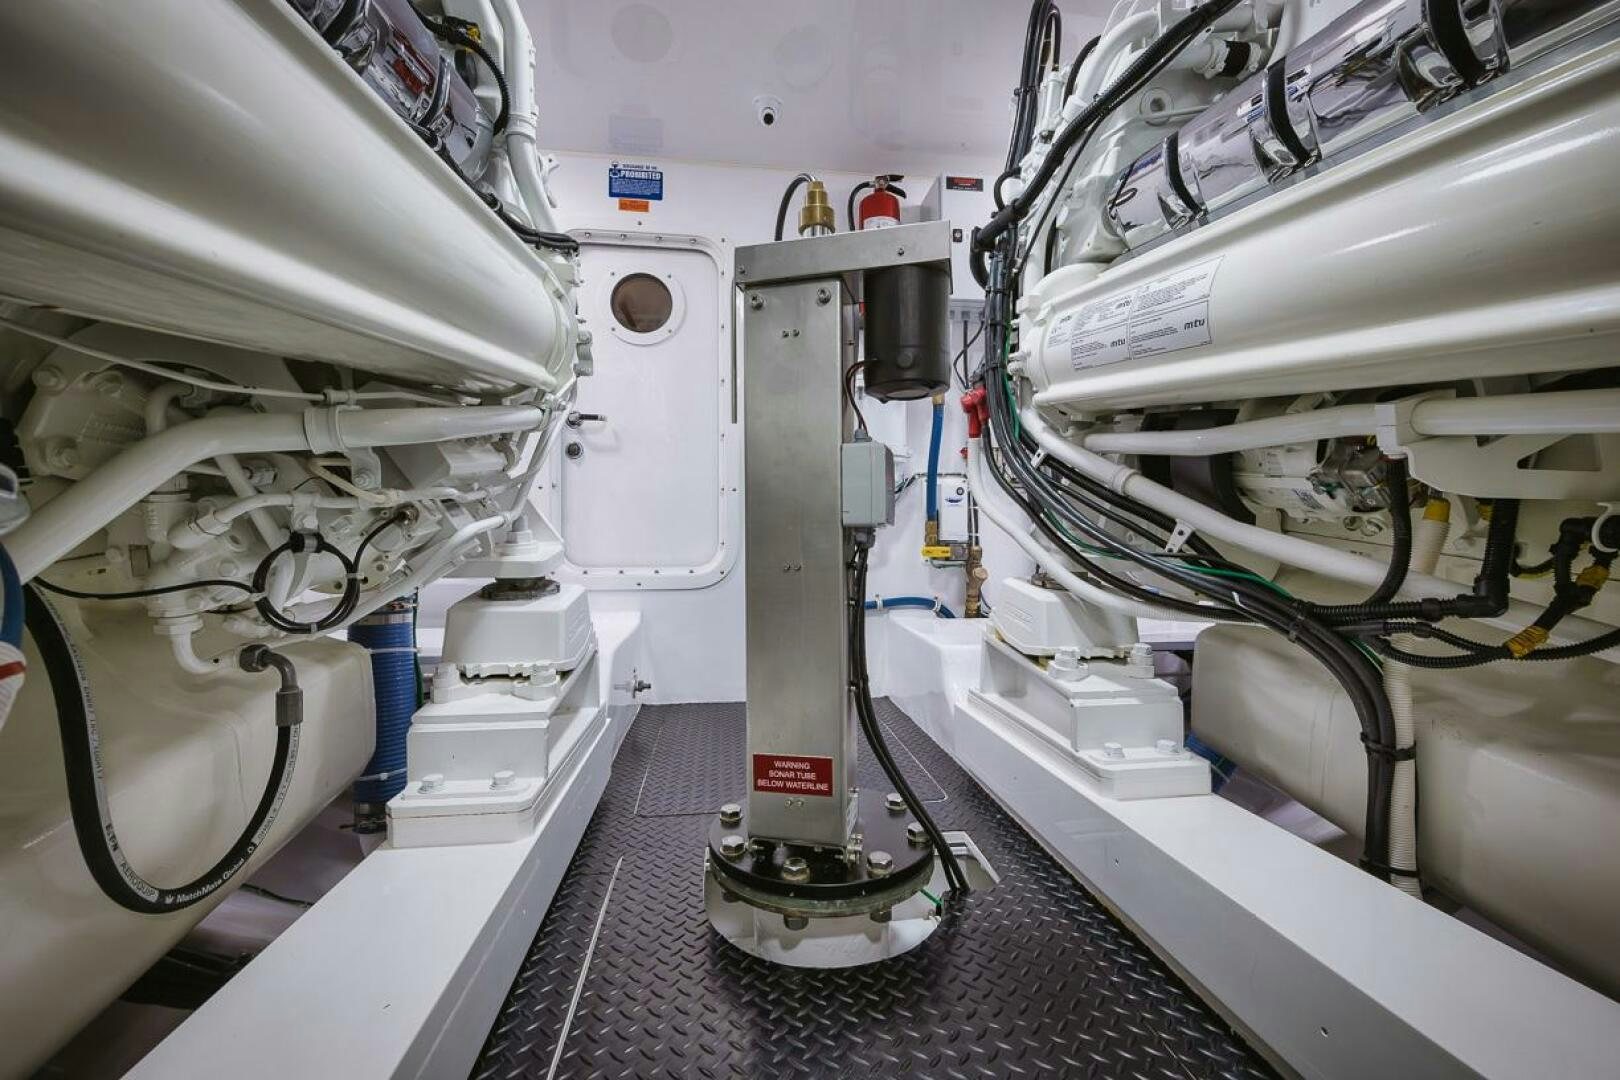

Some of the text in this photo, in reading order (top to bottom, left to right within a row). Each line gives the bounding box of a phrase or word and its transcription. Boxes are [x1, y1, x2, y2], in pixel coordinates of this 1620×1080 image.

[1184, 318, 1205, 330] mtu
[1110, 338, 1126, 348] mtu
[774, 760, 810, 769] WARNING
[768, 769, 816, 780] SONAR TUBE
[757, 778, 829, 791] BELOW WATERLINE
